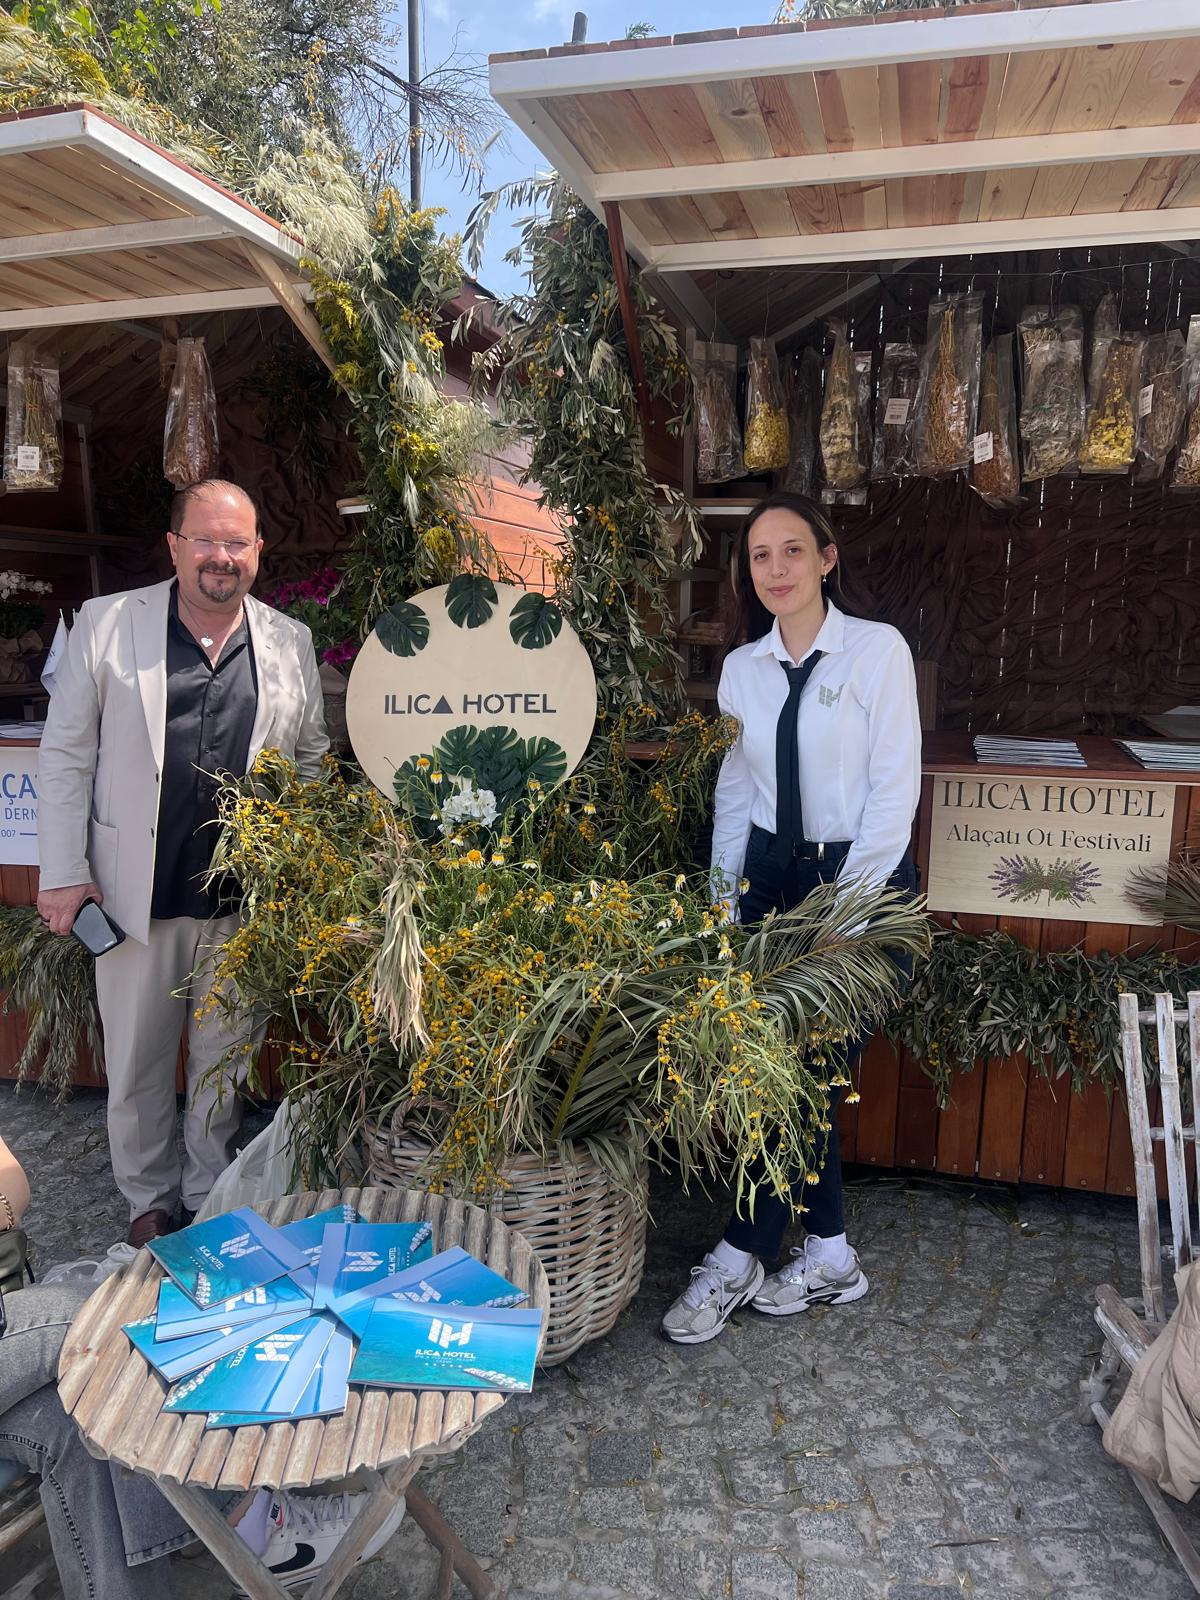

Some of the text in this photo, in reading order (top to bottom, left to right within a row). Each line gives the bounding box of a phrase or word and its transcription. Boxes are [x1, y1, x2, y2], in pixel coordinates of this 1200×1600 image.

[384, 693, 557, 715] ILICA HOTEL
[0, 773, 38, 806] ÇA
[941, 781, 1166, 818] ILICA HOTEL
[946, 823, 1152, 853] Alaçatı Ot Festivali
[415, 1348, 441, 1357] ILICA
[443, 1351, 476, 1359] HOTEL
